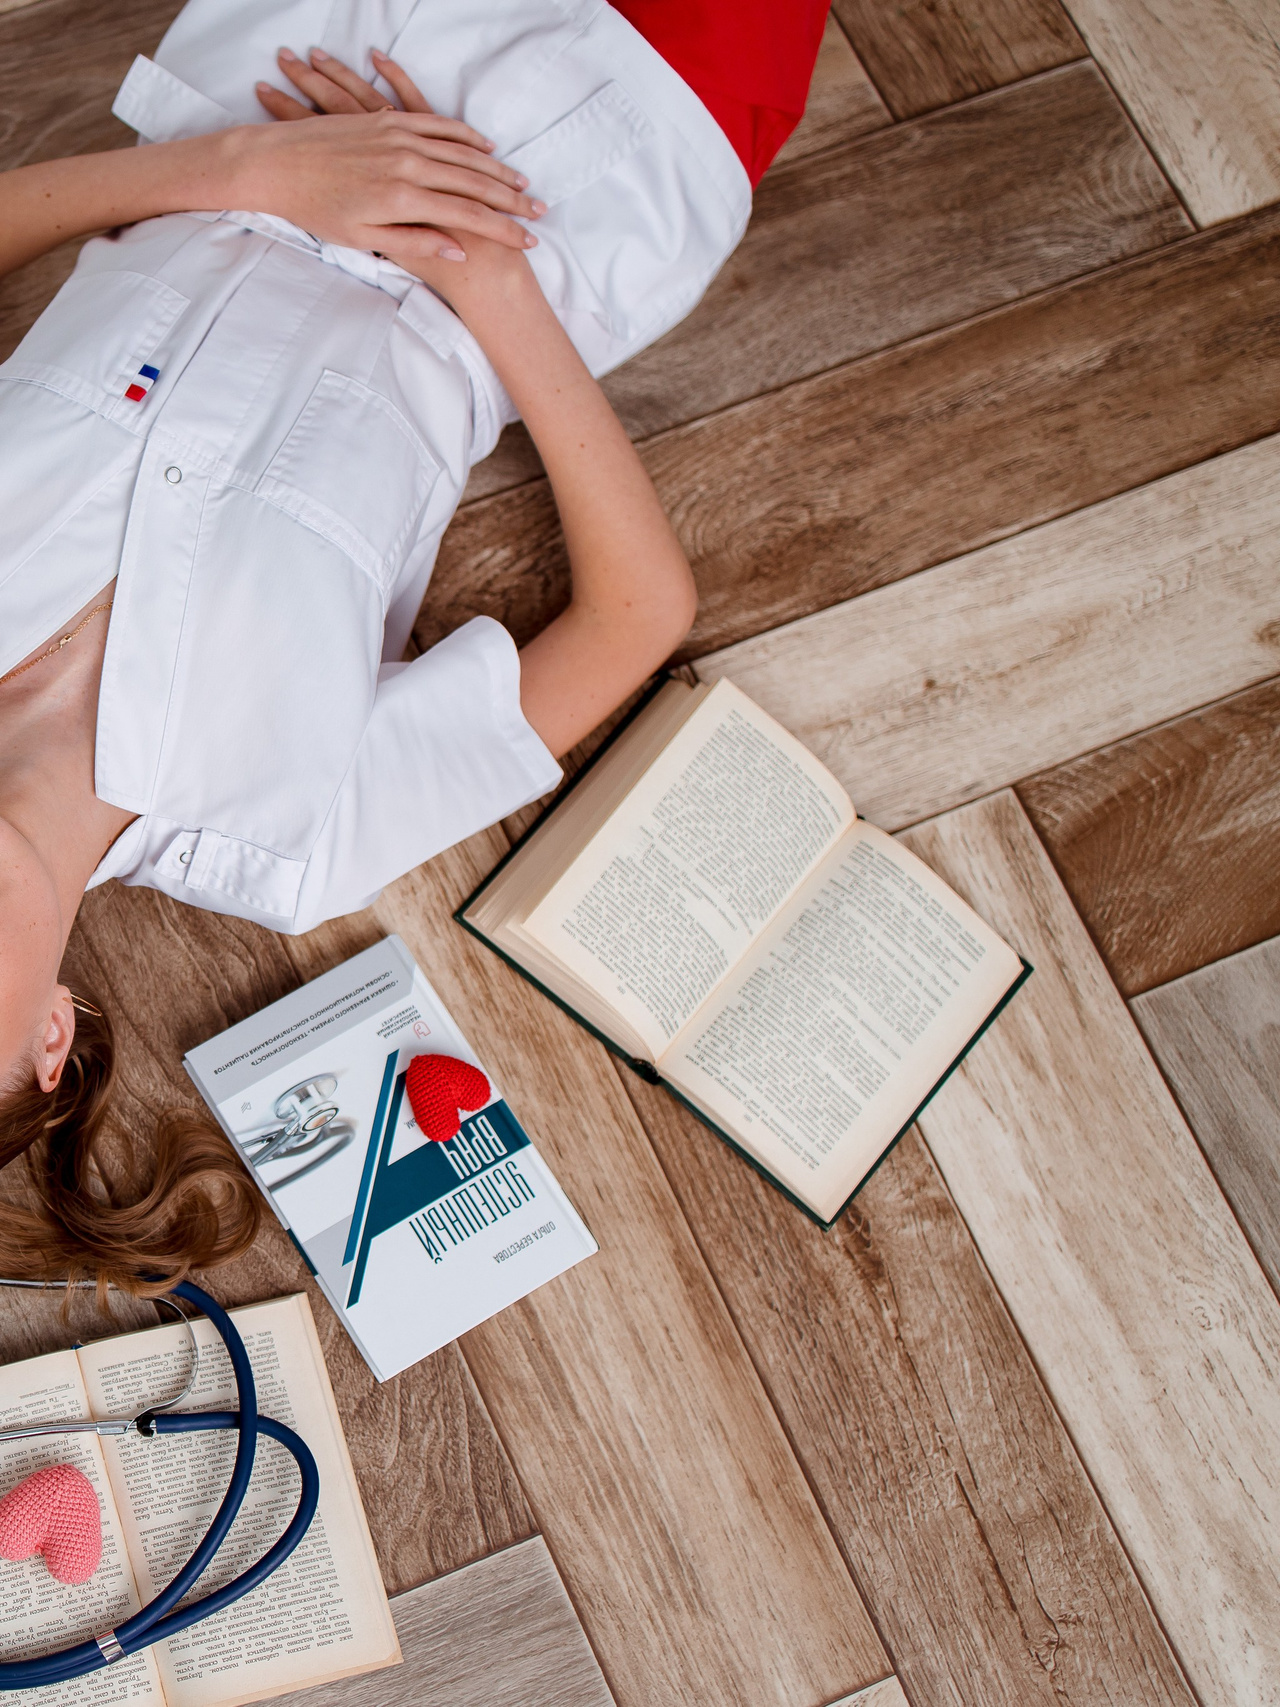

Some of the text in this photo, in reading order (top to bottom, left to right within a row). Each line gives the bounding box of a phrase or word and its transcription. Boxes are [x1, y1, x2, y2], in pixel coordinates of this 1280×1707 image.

[310, 981, 395, 1032] ОШИБКИ ВРАЧЕБНОГО ПРИЕМА
[381, 1004, 414, 1026] УНИВЕРСИТЕТ
[213, 972, 389, 1074] ОСНОВЫ МОТИВАЦИОННОГО КОНСУЛЬТИРОВАНИЯ ПАЦИЕНТОВ
[376, 1009, 417, 1036] КОРПОРАТИВНЫЙ
[382, 1014, 420, 1038] МЕДИЦИНСКИЙ
[250, 1032, 307, 1065] ТЕХНОЛОГИЧНОСТЬ
[438, 1114, 508, 1181] ВРАЧ
[408, 1160, 535, 1264] УСПЕШНЫЙ
[492, 1220, 556, 1264] ОЛЬГА БЕРЕСТОВА
[80, 1594, 93, 1602] тебя
[29, 1606, 49, 1615] совсем
[313, 1608, 328, 1616] Куда
[310, 1616, 326, 1624] рука,
[228, 1626, 258, 1637] торопливо
[248, 1626, 289, 1640] опустившаяся
[315, 1624, 330, 1632] вдруг
[191, 1635, 220, 1646] тревожно
[268, 1628, 312, 1642] почувствовала,
[339, 1633, 353, 1641] даже
[168, 1643, 189, 1653] мягкий
[174, 1626, 351, 1674] продолжала медленно пробираться вперед сквозь кусты,
[198, 1646, 241, 1660] останавливает
[284, 1644, 310, 1653] детским,
[173, 1658, 195, 1666] челове-
[244, 1652, 279, 1664] слабеньким
[208, 1662, 238, 1673] голоском.
[176, 1670, 202, 1682] Девушка
